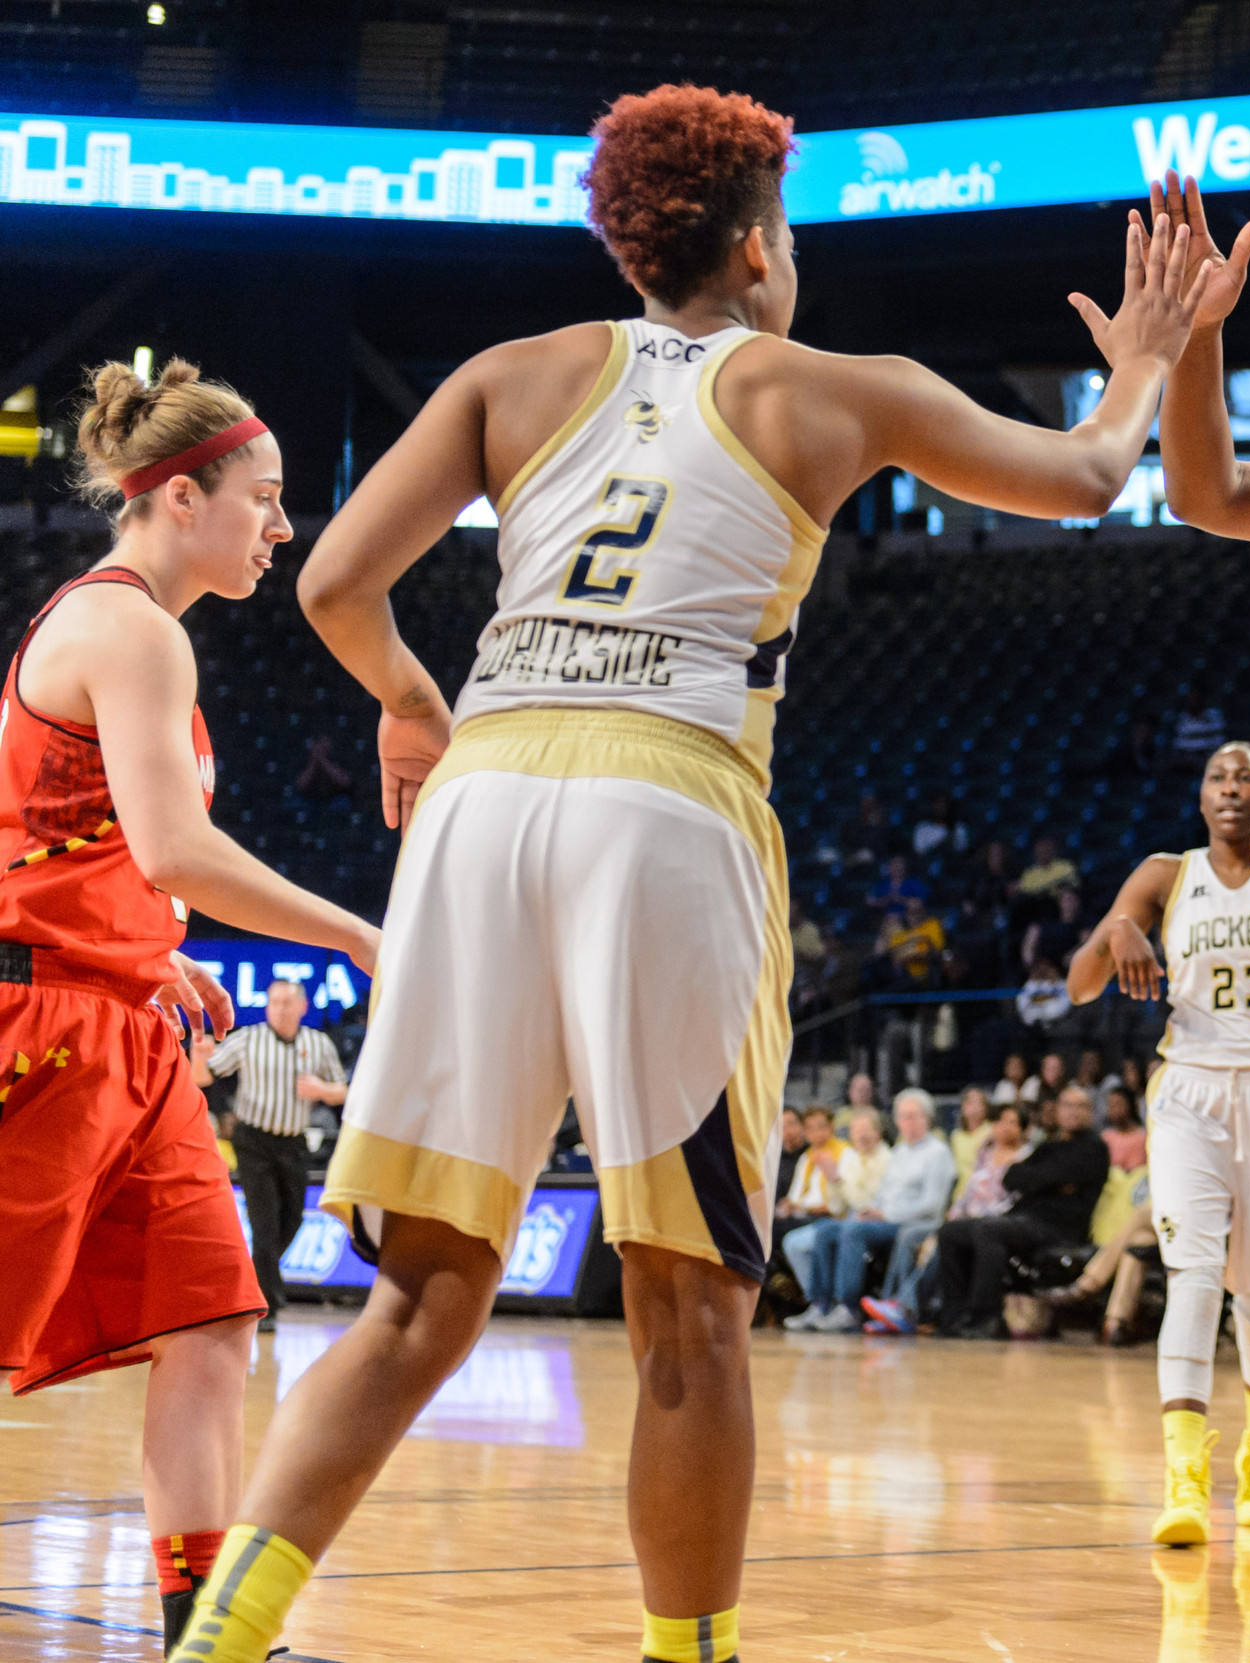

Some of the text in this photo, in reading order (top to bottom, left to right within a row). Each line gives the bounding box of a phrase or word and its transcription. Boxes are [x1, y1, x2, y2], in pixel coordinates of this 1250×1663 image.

[838, 162, 996, 216] airwatch
[636, 338, 706, 364] ACC
[556, 471, 674, 612] 2
